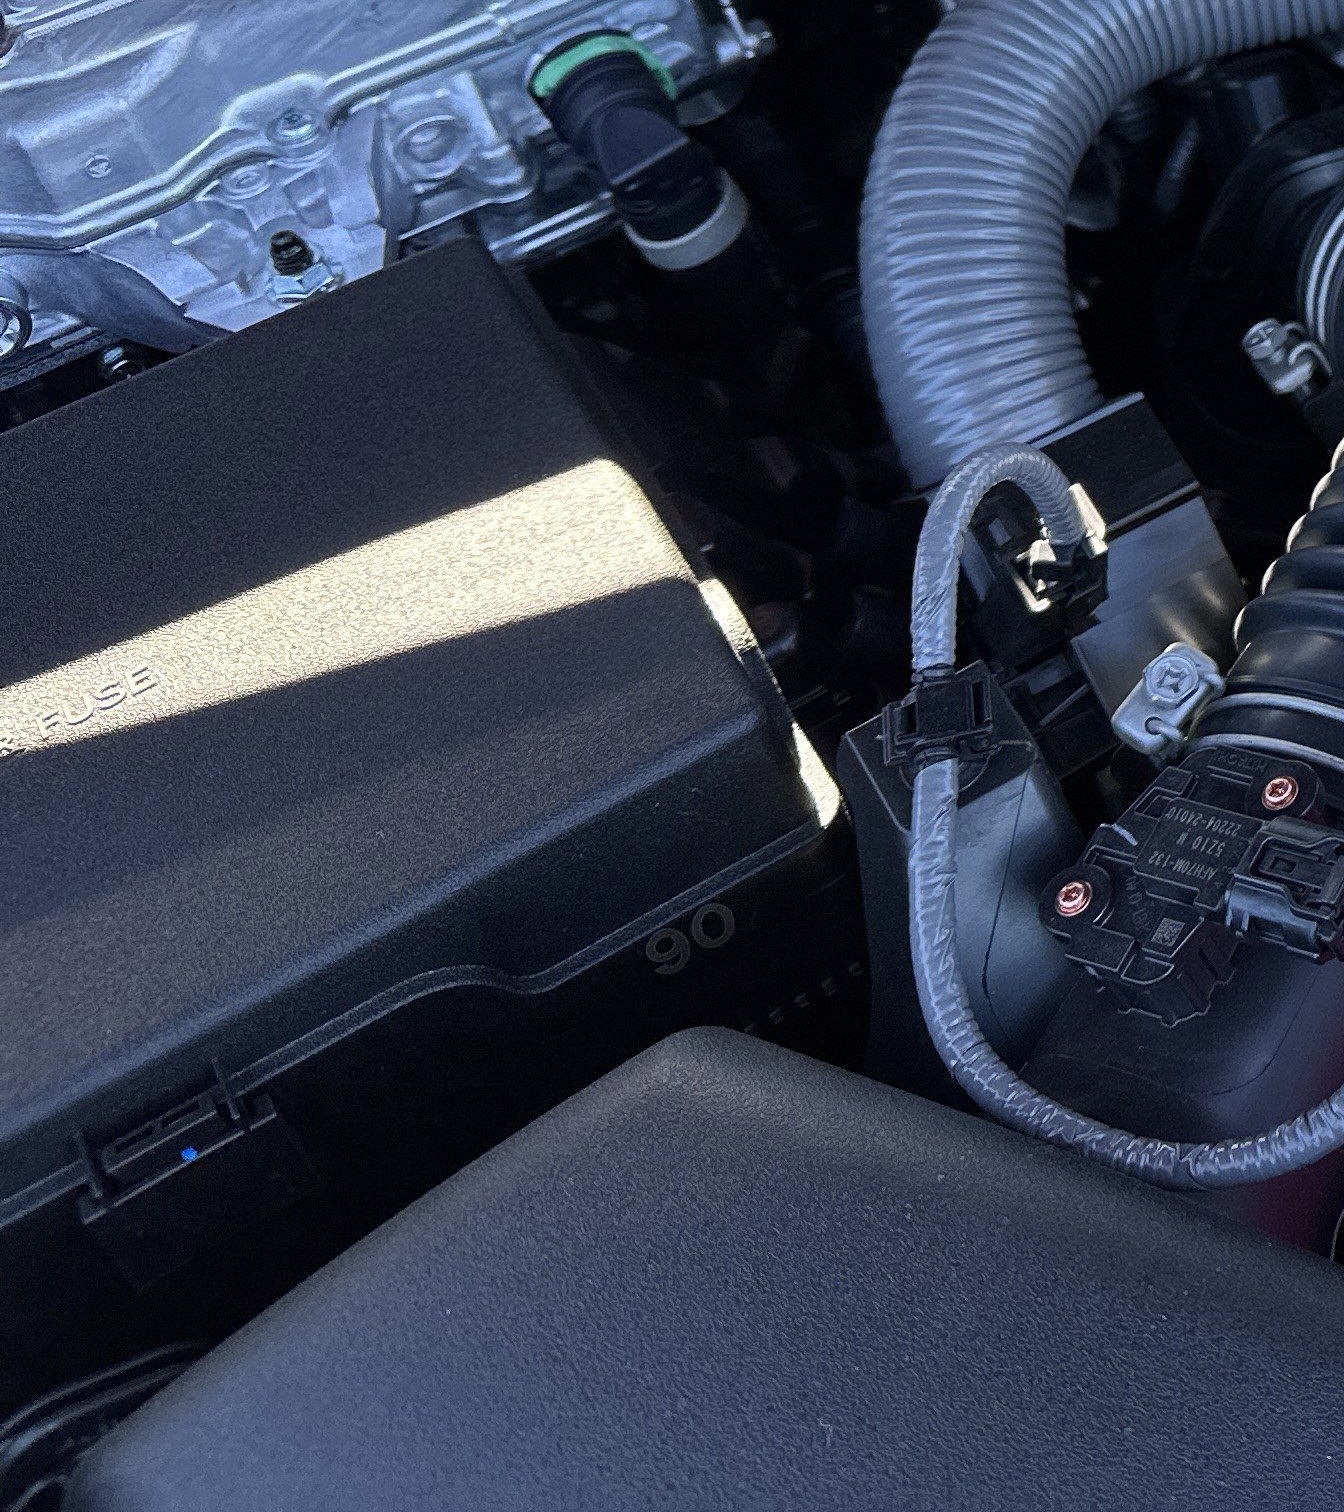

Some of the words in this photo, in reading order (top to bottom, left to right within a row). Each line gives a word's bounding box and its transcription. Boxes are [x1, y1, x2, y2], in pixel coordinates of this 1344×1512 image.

[37, 666, 158, 742] FUSE
[1148, 850, 1218, 880] AFH70M-132
[645, 901, 736, 976] 90
